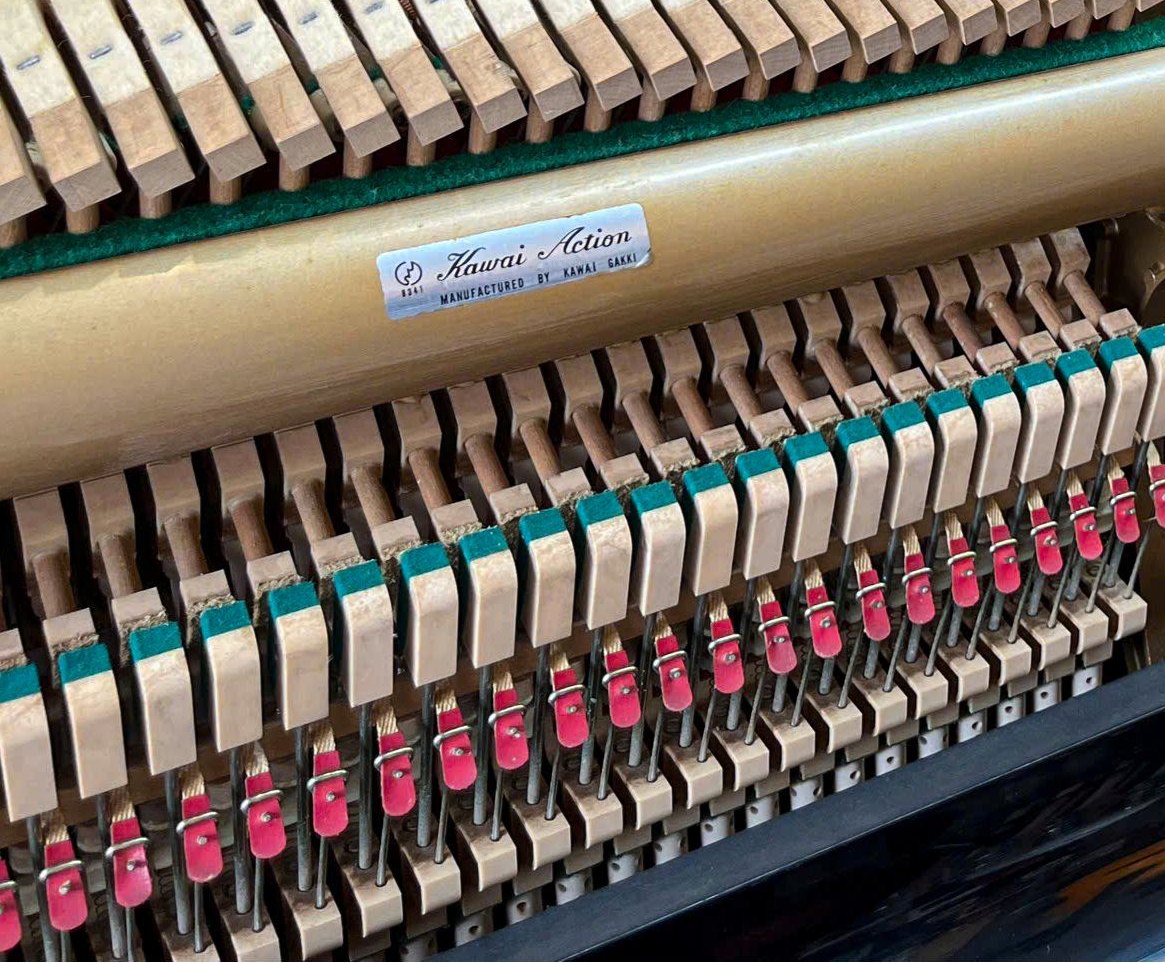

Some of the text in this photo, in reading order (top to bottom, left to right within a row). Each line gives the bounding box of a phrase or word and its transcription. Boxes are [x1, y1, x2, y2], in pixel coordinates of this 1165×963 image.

[436, 226, 632, 282] Kawai Action
[440, 252, 637, 305] MANUFACTURED BY KAWAI GAKKI
